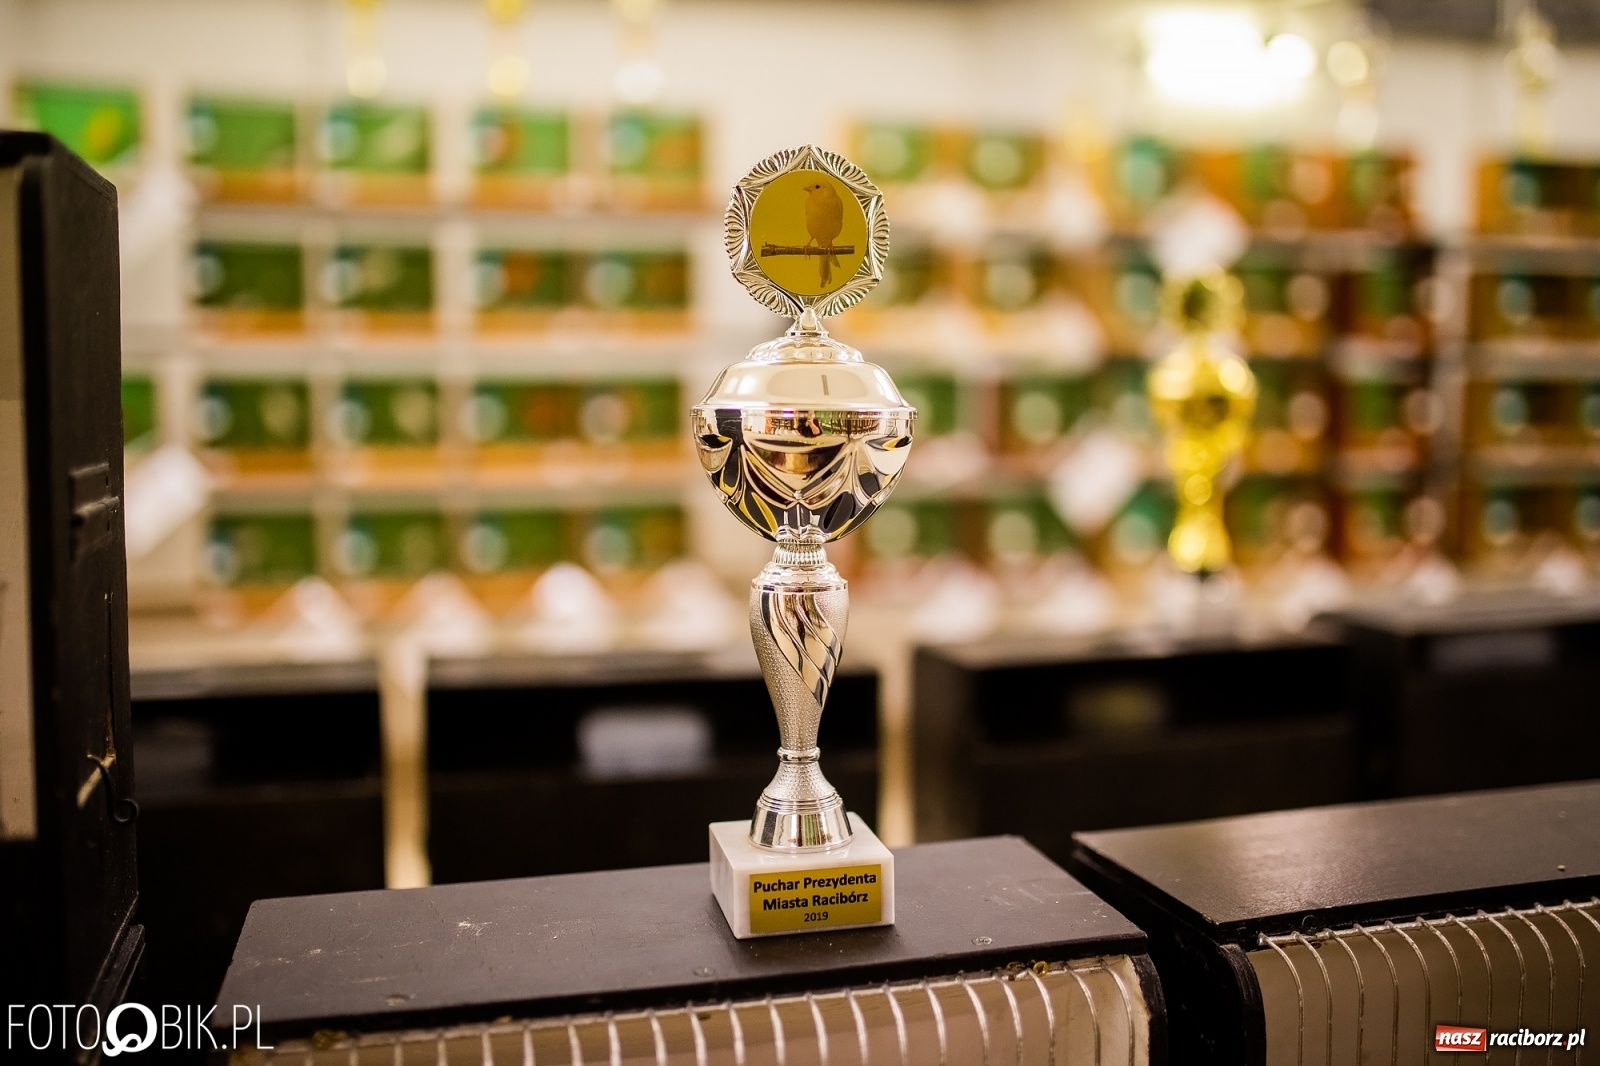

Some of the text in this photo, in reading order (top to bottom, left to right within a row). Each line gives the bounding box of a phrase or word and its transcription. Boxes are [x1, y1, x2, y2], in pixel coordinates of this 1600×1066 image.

[753, 873, 877, 893] Puchar Prezydenta
[763, 891, 869, 911] Miasta Racibórz
[804, 911, 829, 923] 2019
